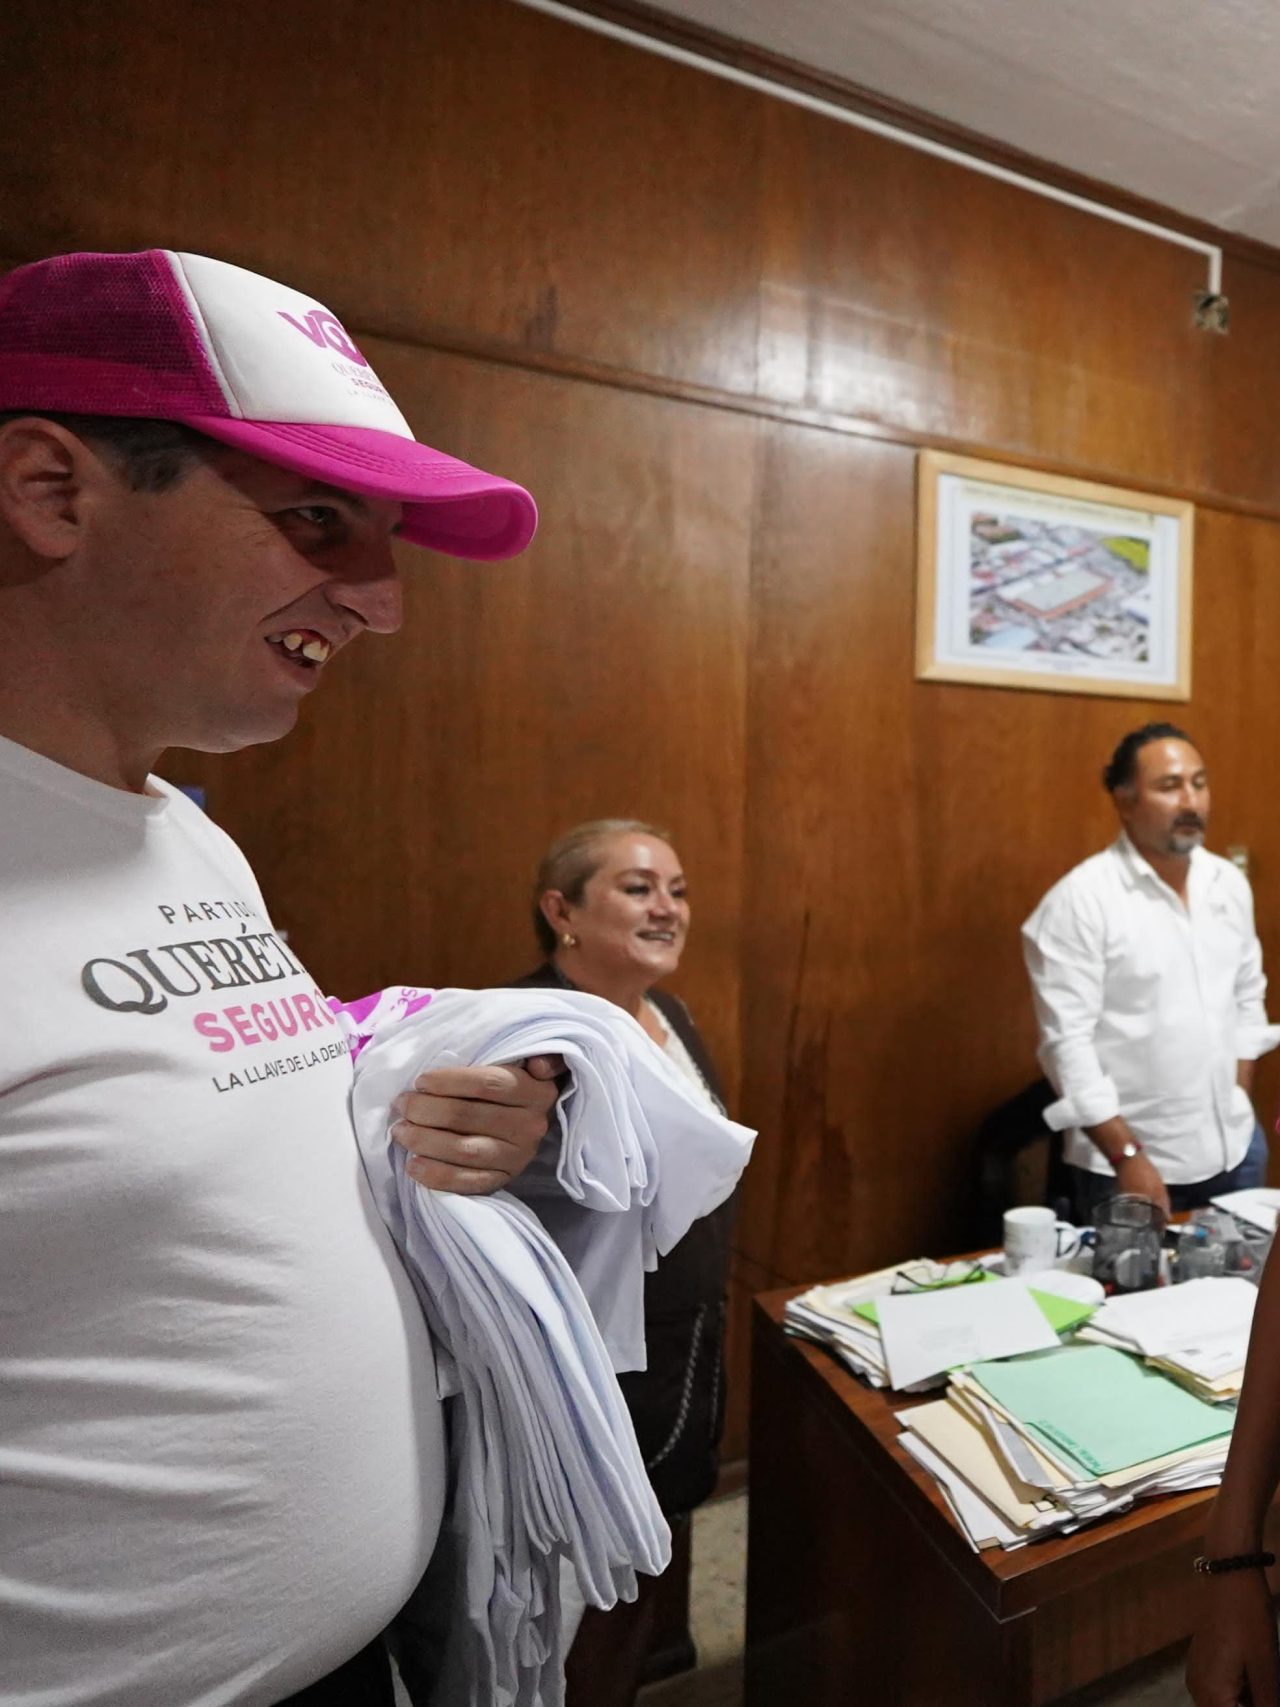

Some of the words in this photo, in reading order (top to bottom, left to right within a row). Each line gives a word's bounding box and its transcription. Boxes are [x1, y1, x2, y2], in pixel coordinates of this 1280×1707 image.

[158, 901, 257, 924] PARTID
[81, 922, 306, 1015] QUERÉT
[212, 1072, 244, 1093] LA
[244, 1058, 287, 1084] LLAVE
[286, 1055, 304, 1073] DE
[303, 1050, 321, 1068] LA
